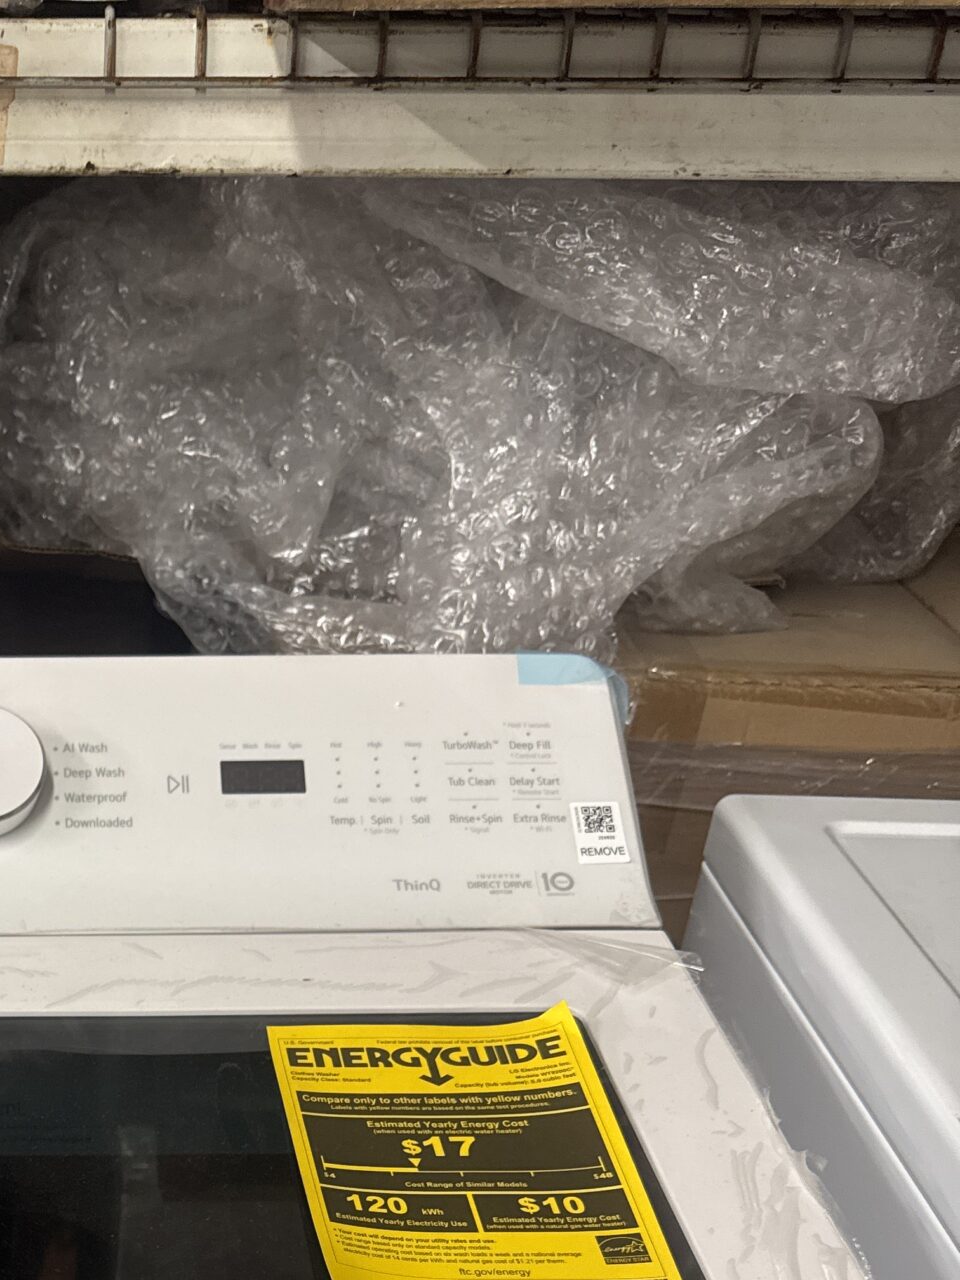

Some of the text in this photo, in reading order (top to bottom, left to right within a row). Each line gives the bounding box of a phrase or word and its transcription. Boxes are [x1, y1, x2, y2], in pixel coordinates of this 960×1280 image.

[62, 743, 108, 753] AI Wash
[509, 740, 551, 751] Deep Fill
[63, 767, 125, 780] Deep Wash
[448, 777, 496, 786] Tub Clean
[509, 777, 561, 788] Delay Start
[64, 792, 128, 805] Waterproof
[64, 816, 133, 828] Downloaded
[370, 815, 393, 826] Spin
[411, 814, 430, 824] Soil
[513, 813, 567, 823] Extra Rinse
[580, 846, 626, 857] REMOVE
[393, 879, 441, 892] ThinQ
[467, 880, 533, 889] DIRECT DRIVE
[285, 1035, 567, 1069] ENERGYGUIDE
[302, 1089, 578, 1106] Compare only to other labels with yellow numbers.
[366, 1119, 529, 1129] Estimated Yearly Energy Cost
[401, 1135, 476, 1156] $17
[346, 1194, 444, 1216] 120 kWh
[518, 1196, 586, 1215] $10
[335, 1212, 377, 1223] Estimated
[378, 1218, 405, 1227] Yearly
[406, 1220, 449, 1228] Electricity
[538, 1216, 564, 1224] Yearly
[566, 1216, 597, 1224] Energy
[380, 1235, 404, 1243] depend
[459, 1268, 531, 1277] ftc.gov/energy
